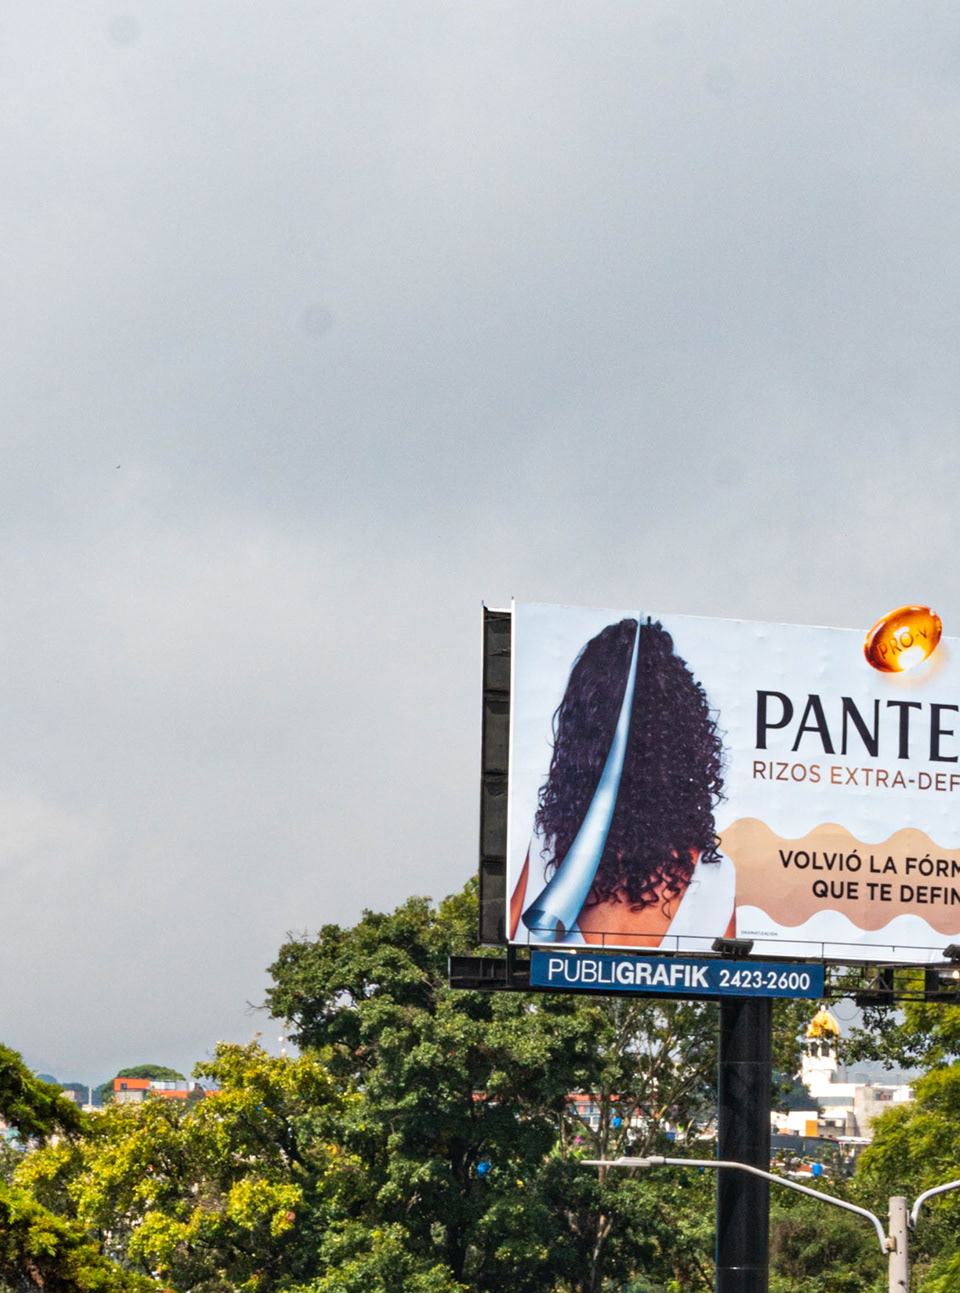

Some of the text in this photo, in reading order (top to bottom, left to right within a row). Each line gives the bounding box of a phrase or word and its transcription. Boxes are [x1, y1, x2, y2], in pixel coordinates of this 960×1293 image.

[752, 760, 822, 784] RIZOS
[779, 850, 862, 874] VOLVIÓ
[869, 855, 898, 875] LA
[812, 879, 859, 900] QUE
[866, 883, 892, 901] TE
[548, 957, 811, 990] PUBLIGRAFIK 2423-2600
